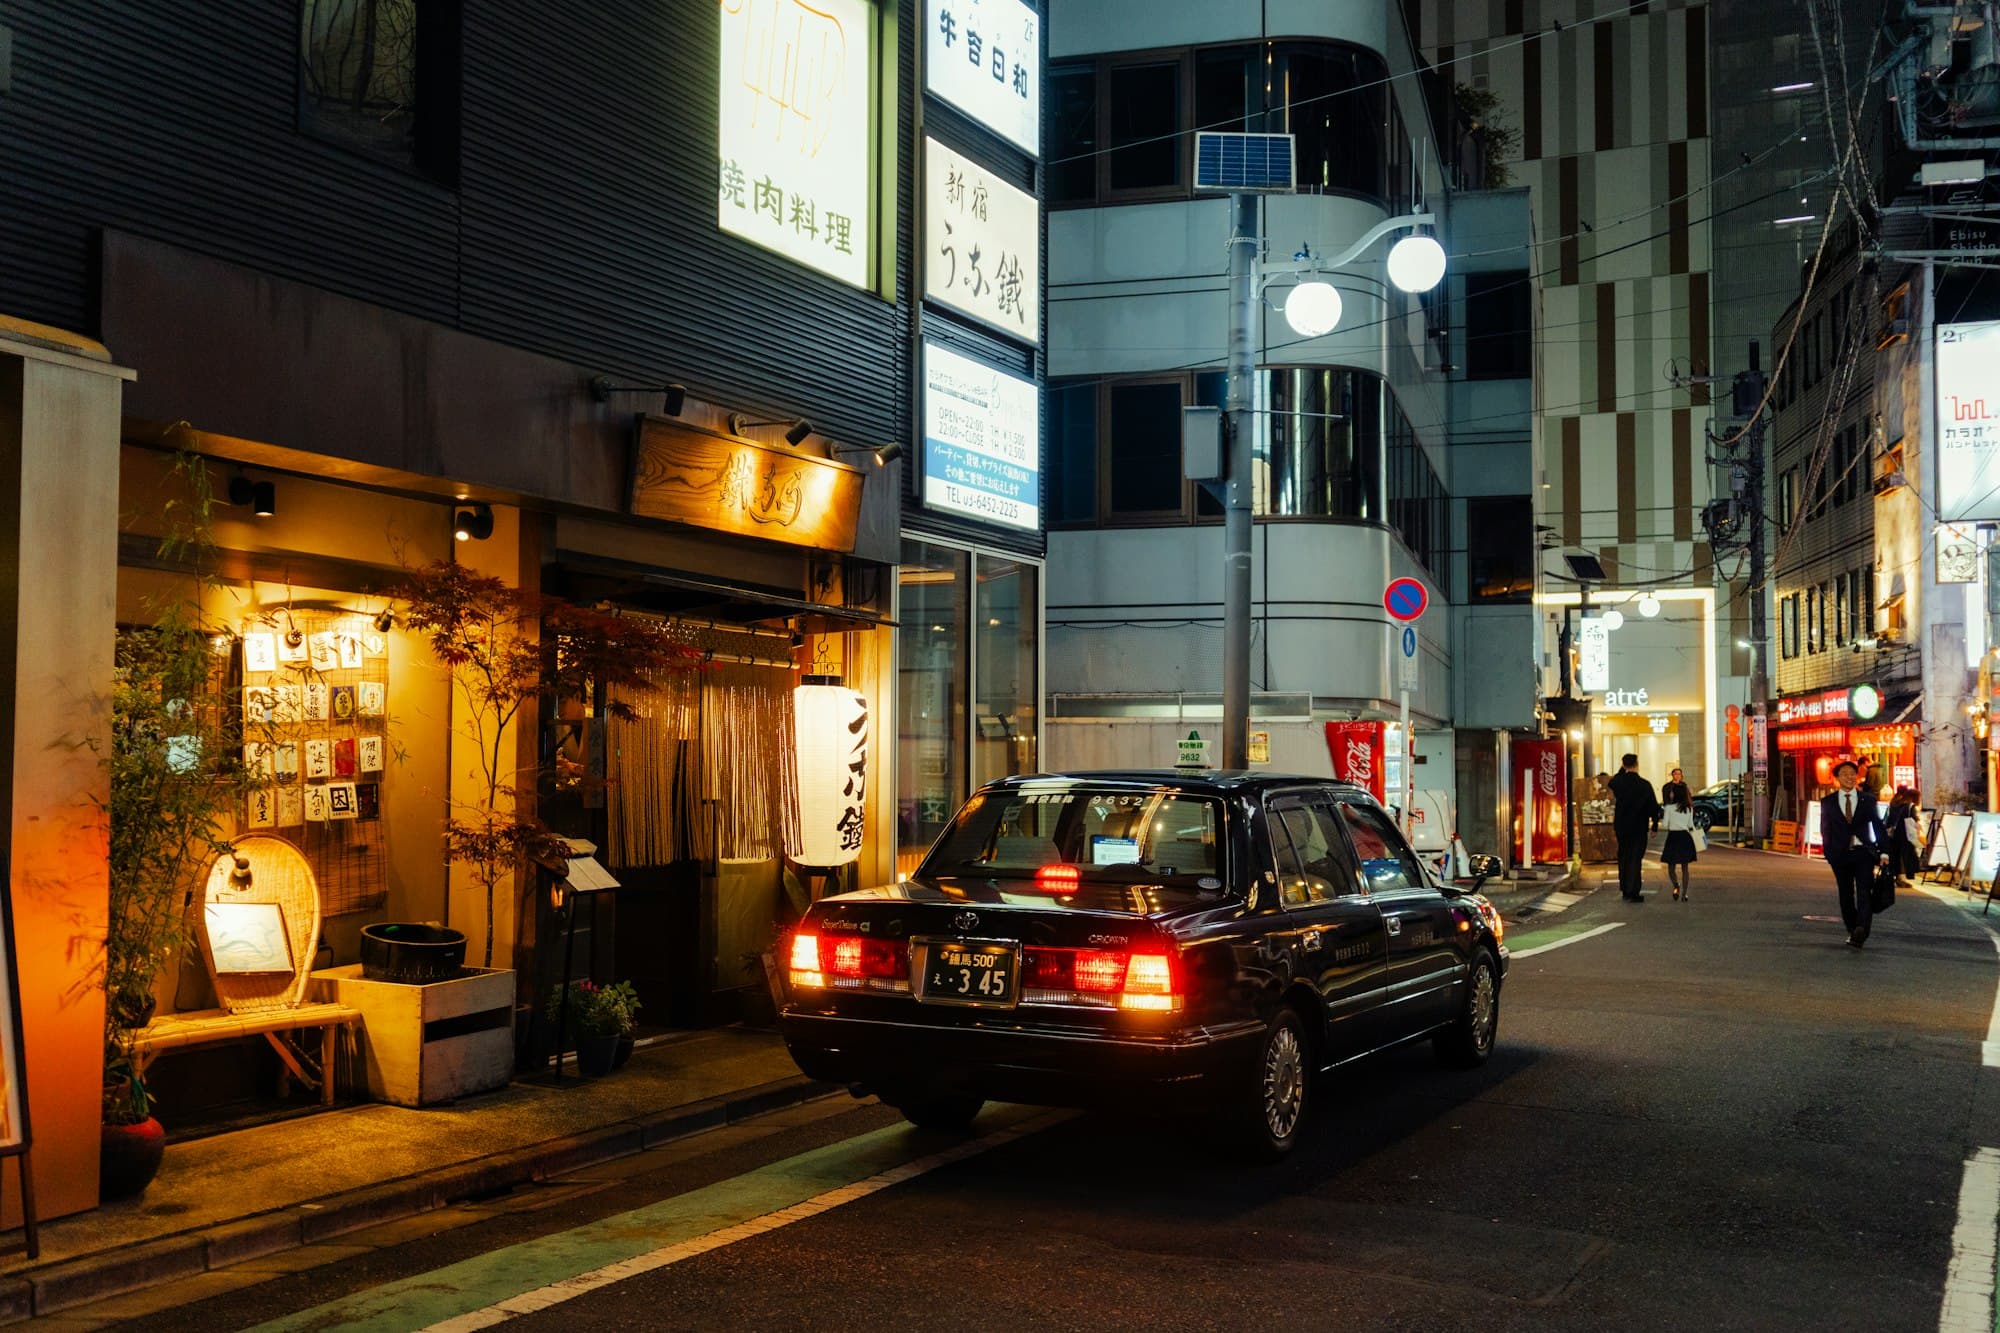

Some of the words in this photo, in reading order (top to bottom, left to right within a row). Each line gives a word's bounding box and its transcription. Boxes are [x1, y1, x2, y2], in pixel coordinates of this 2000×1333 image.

[944, 162, 989, 223] 新宿
[719, 157, 853, 257] 焼肉料理
[1950, 229, 1987, 241] Ebisu
[1943, 329, 1966, 343] 2F
[946, 486, 962, 505] TEL
[1605, 688, 1649, 706] atré
[1180, 752, 1201, 762] 9632
[1088, 934, 1129, 945] CROWN
[973, 954, 994, 968] 500
[933, 973, 942, 985] え
